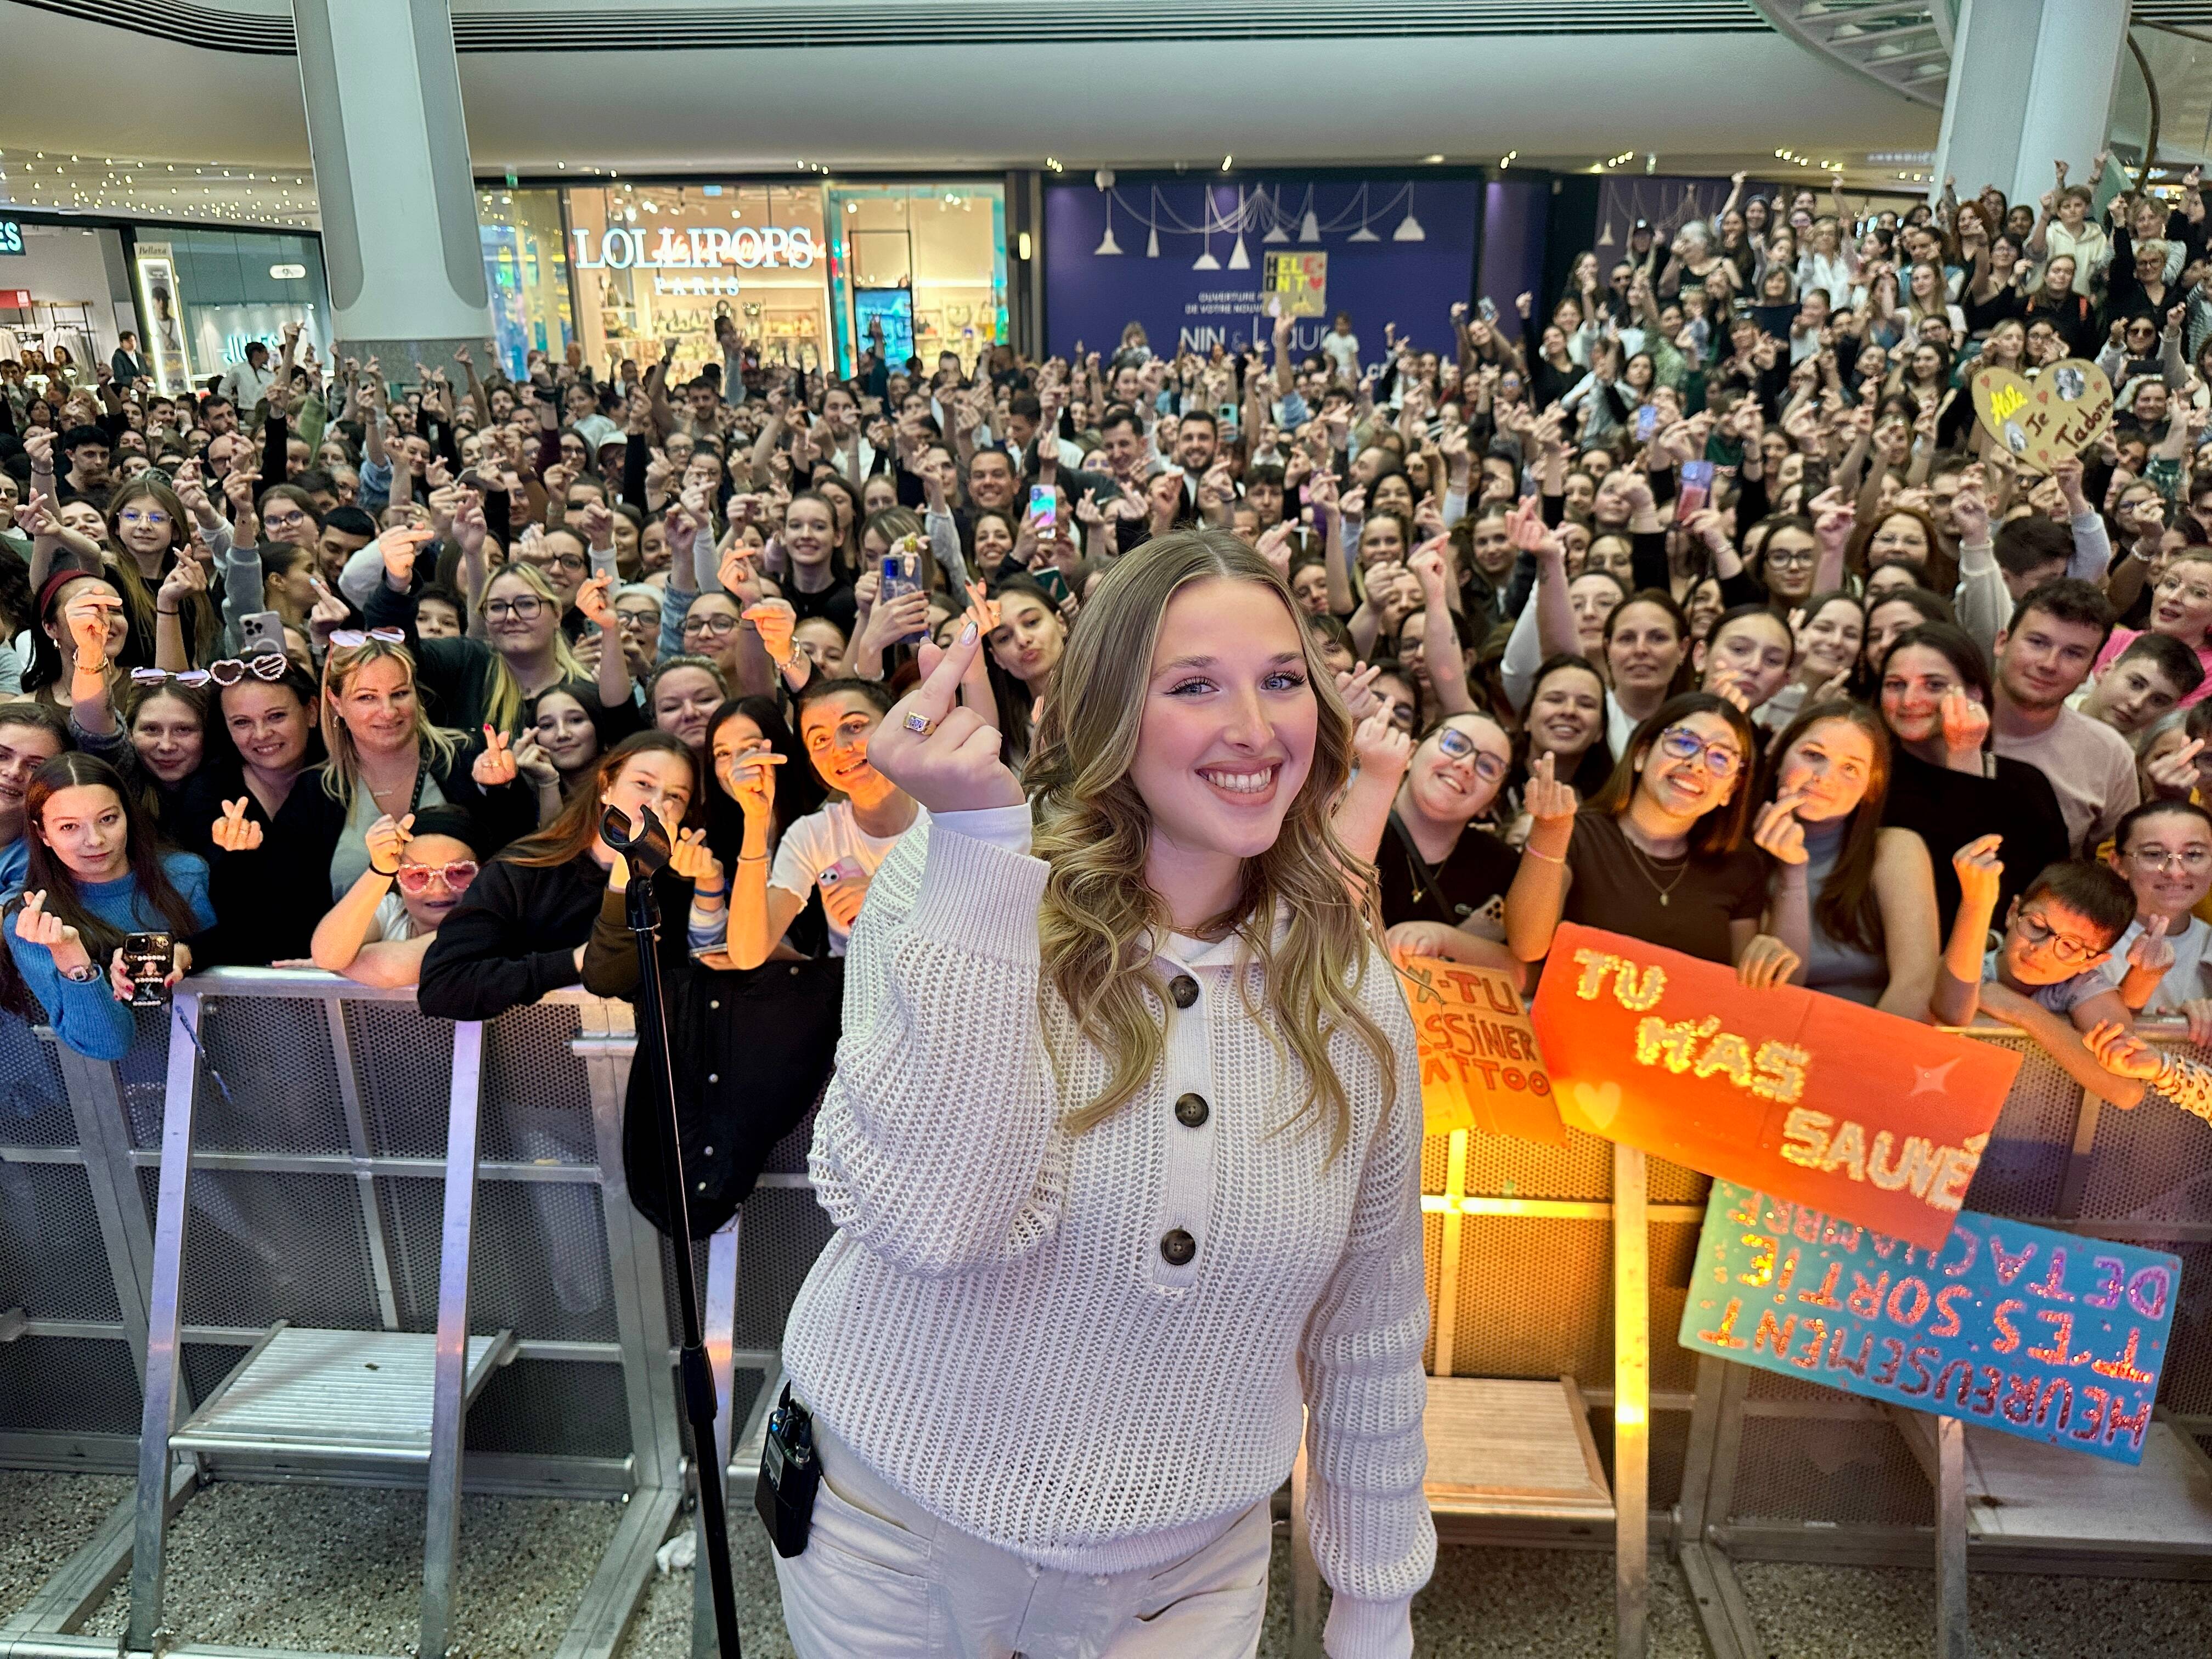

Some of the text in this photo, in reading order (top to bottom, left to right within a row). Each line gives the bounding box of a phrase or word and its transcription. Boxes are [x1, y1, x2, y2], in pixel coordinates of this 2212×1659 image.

[572, 227, 813, 269] LOLLIPOPS
[654, 276, 740, 296] PARIS
[2025, 412, 2049, 437] Je
[1573, 949, 1668, 1011] TU
[1419, 1044, 1550, 1097] ATTOO
[1636, 1015, 1810, 1104] M'AS
[1990, 1235, 2076, 1304] TA
[2084, 1256, 2170, 1321] DE
[1698, 1297, 2154, 1450] HEUREUSEMENT
